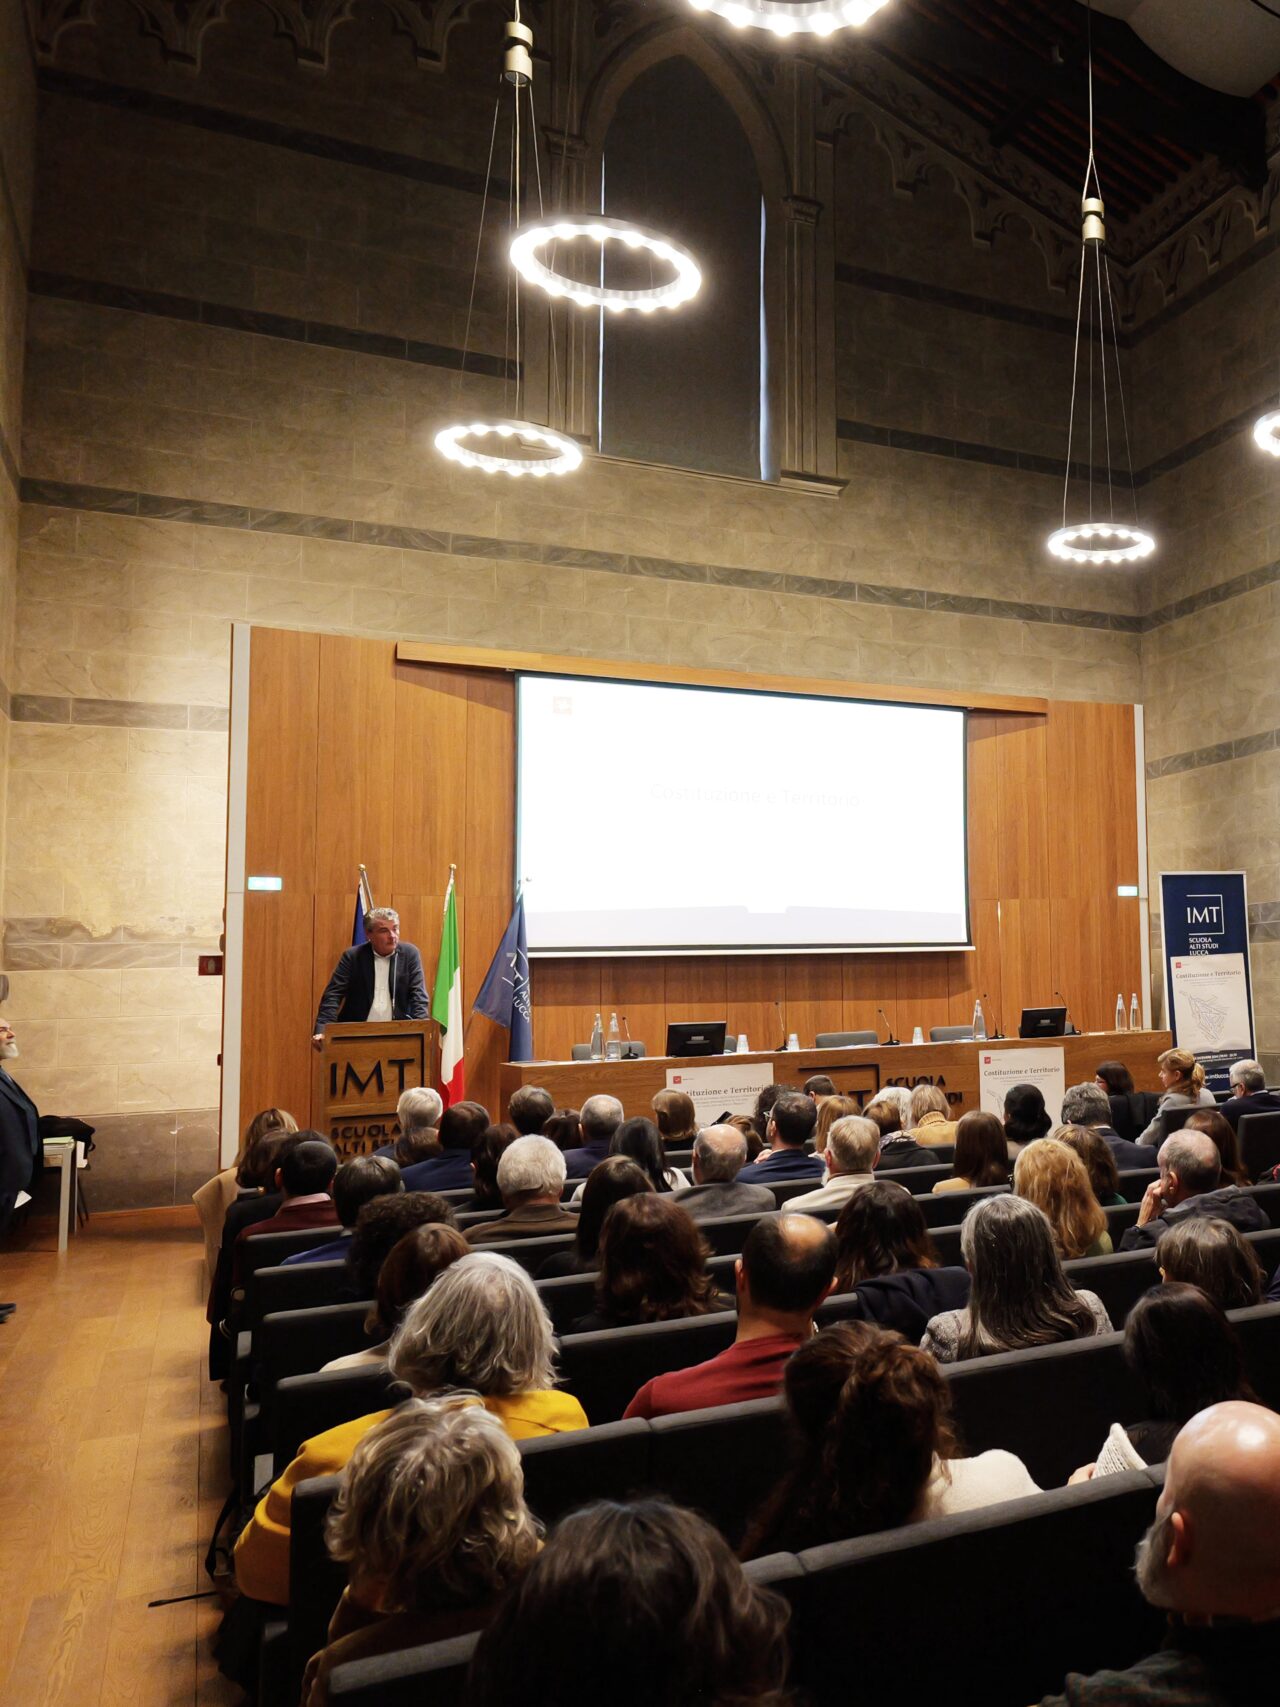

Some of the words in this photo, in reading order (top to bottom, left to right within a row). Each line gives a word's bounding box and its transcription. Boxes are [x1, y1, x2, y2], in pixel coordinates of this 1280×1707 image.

[1186, 906, 1220, 924] IMT
[330, 1058, 415, 1098] IMT
[984, 1068, 1023, 1076] Costituzione
[1029, 1066, 1060, 1074] Territorio
[730, 1084, 764, 1094] Territori
[331, 1123, 402, 1139] SCUOLA
